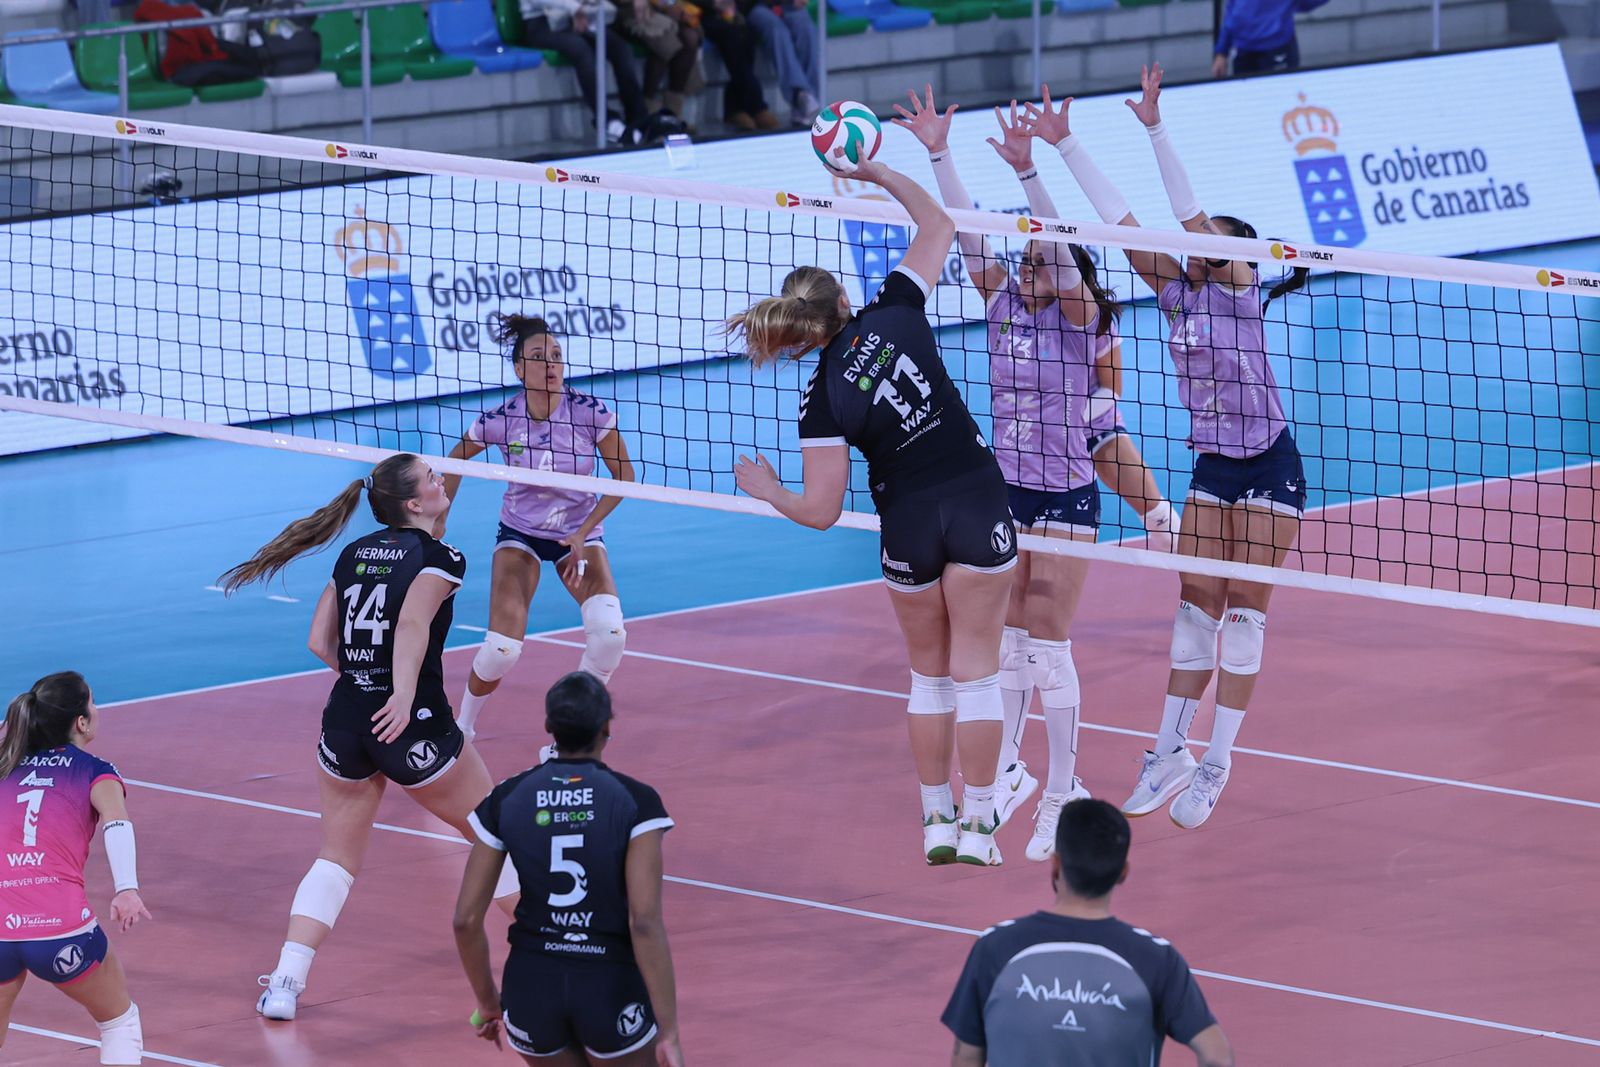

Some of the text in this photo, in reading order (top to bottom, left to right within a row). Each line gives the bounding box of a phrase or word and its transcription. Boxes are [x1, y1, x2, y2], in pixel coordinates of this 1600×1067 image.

[1361, 146, 1487, 186] Gobierno
[1373, 177, 1530, 226] de Canarias
[428, 264, 577, 308] Gobierno
[440, 298, 626, 352] de Carias
[843, 332, 881, 384] EVANS
[868, 341, 895, 379] ERGOS
[872, 353, 932, 420] 11
[900, 401, 931, 433] WAY
[354, 547, 408, 561] HERMAN
[343, 583, 390, 646] 14
[345, 648, 375, 662] WAY
[536, 788, 594, 808] BURSE
[553, 811, 595, 823] ERGOS
[16, 789, 45, 847] 1
[6, 852, 46, 868] WAY
[547, 834, 588, 908] 5
[551, 911, 594, 928] WAY
[1016, 973, 1127, 1012] Andalucía
